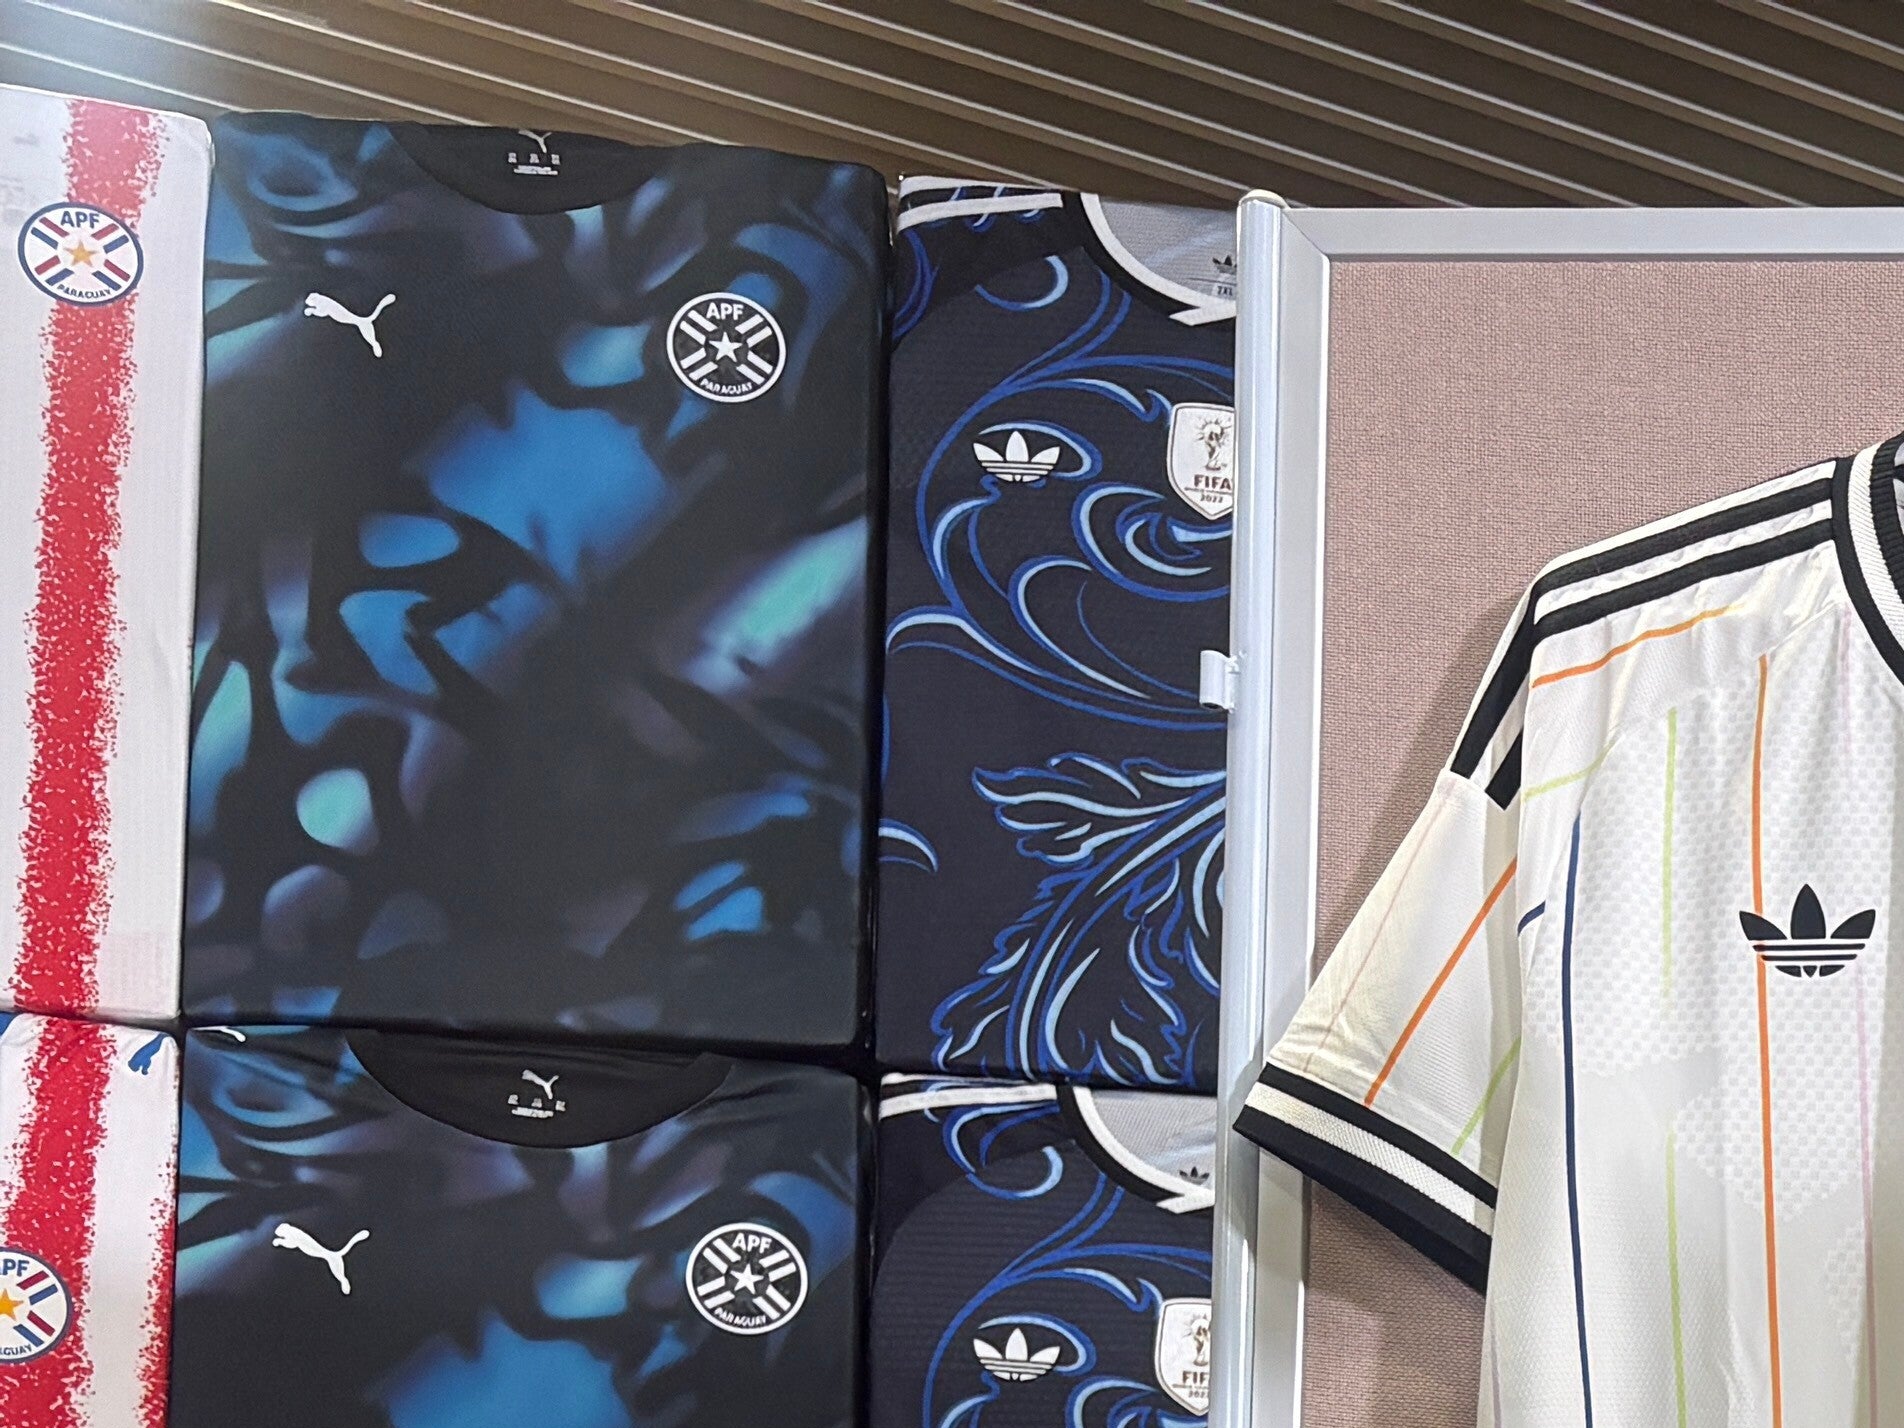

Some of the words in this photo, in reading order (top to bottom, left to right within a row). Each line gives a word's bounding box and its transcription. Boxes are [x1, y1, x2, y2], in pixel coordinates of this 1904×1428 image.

[60, 210, 101, 229] APF
[56, 283, 112, 299] PARAGUAY
[706, 301, 744, 321] APF
[700, 378, 753, 395] PARAGUAY
[1193, 474, 1232, 490] FIFA
[731, 1232, 773, 1254] APF
[0, 1258, 30, 1277] PF
[714, 1307, 767, 1327] PARAGUAY
